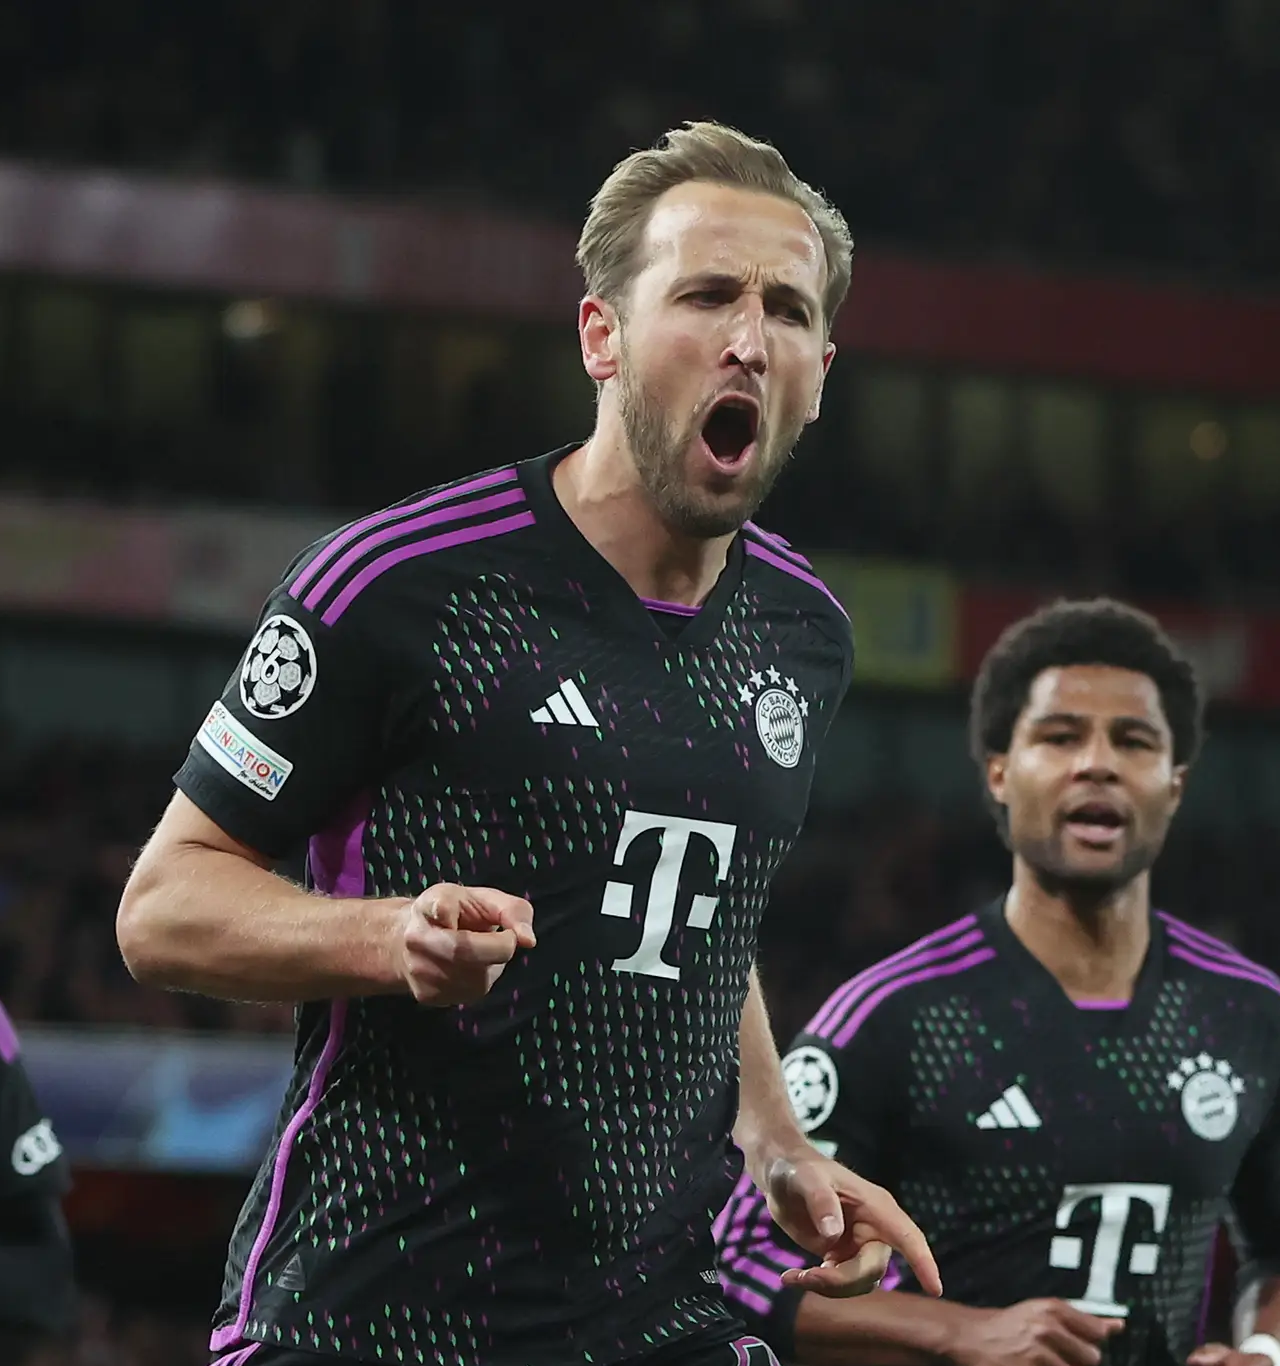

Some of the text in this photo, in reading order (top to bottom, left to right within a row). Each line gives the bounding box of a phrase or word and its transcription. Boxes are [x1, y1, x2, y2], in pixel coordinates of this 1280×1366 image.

[761, 695, 800, 726] FC BAYERN
[205, 714, 284, 787] FOUNDATION
[600, 810, 737, 982] T
